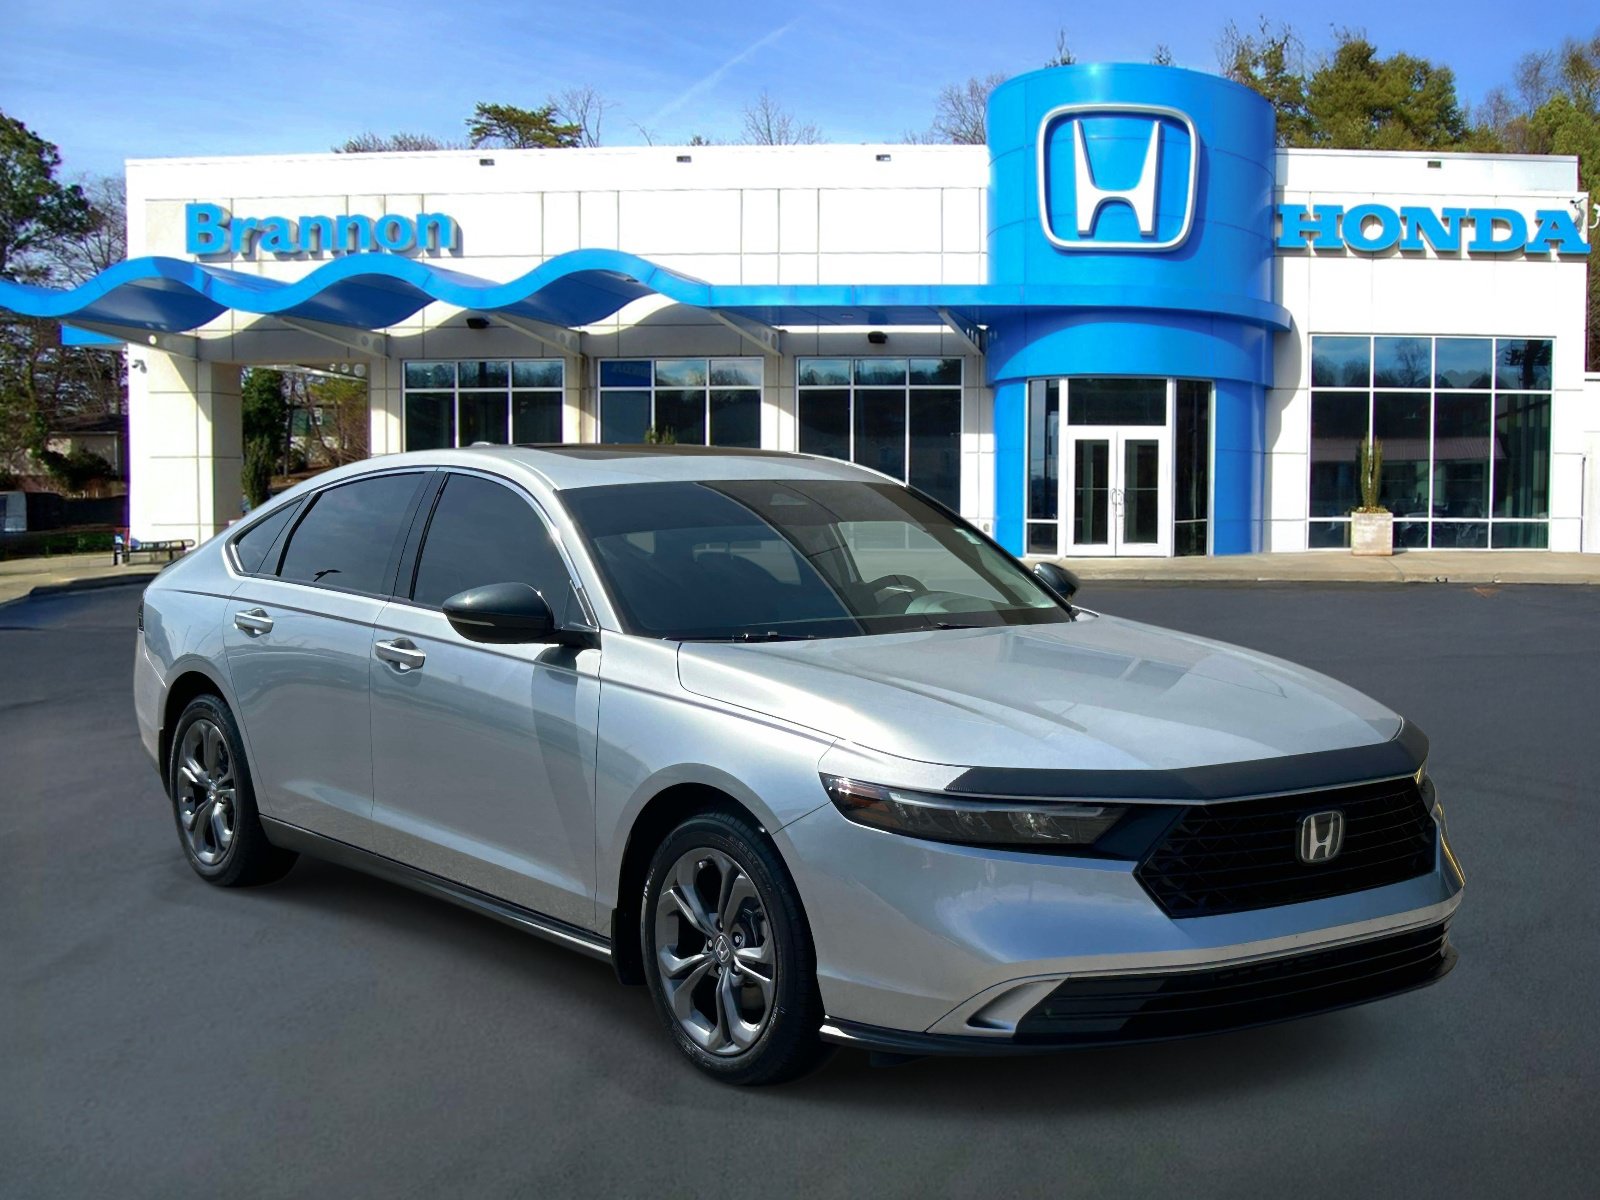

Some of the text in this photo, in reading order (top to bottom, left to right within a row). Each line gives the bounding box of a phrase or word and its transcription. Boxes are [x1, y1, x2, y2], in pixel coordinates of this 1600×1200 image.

[1072, 119, 1160, 236] H
[185, 202, 458, 256] Brannon
[1276, 203, 1591, 254] HONDA
